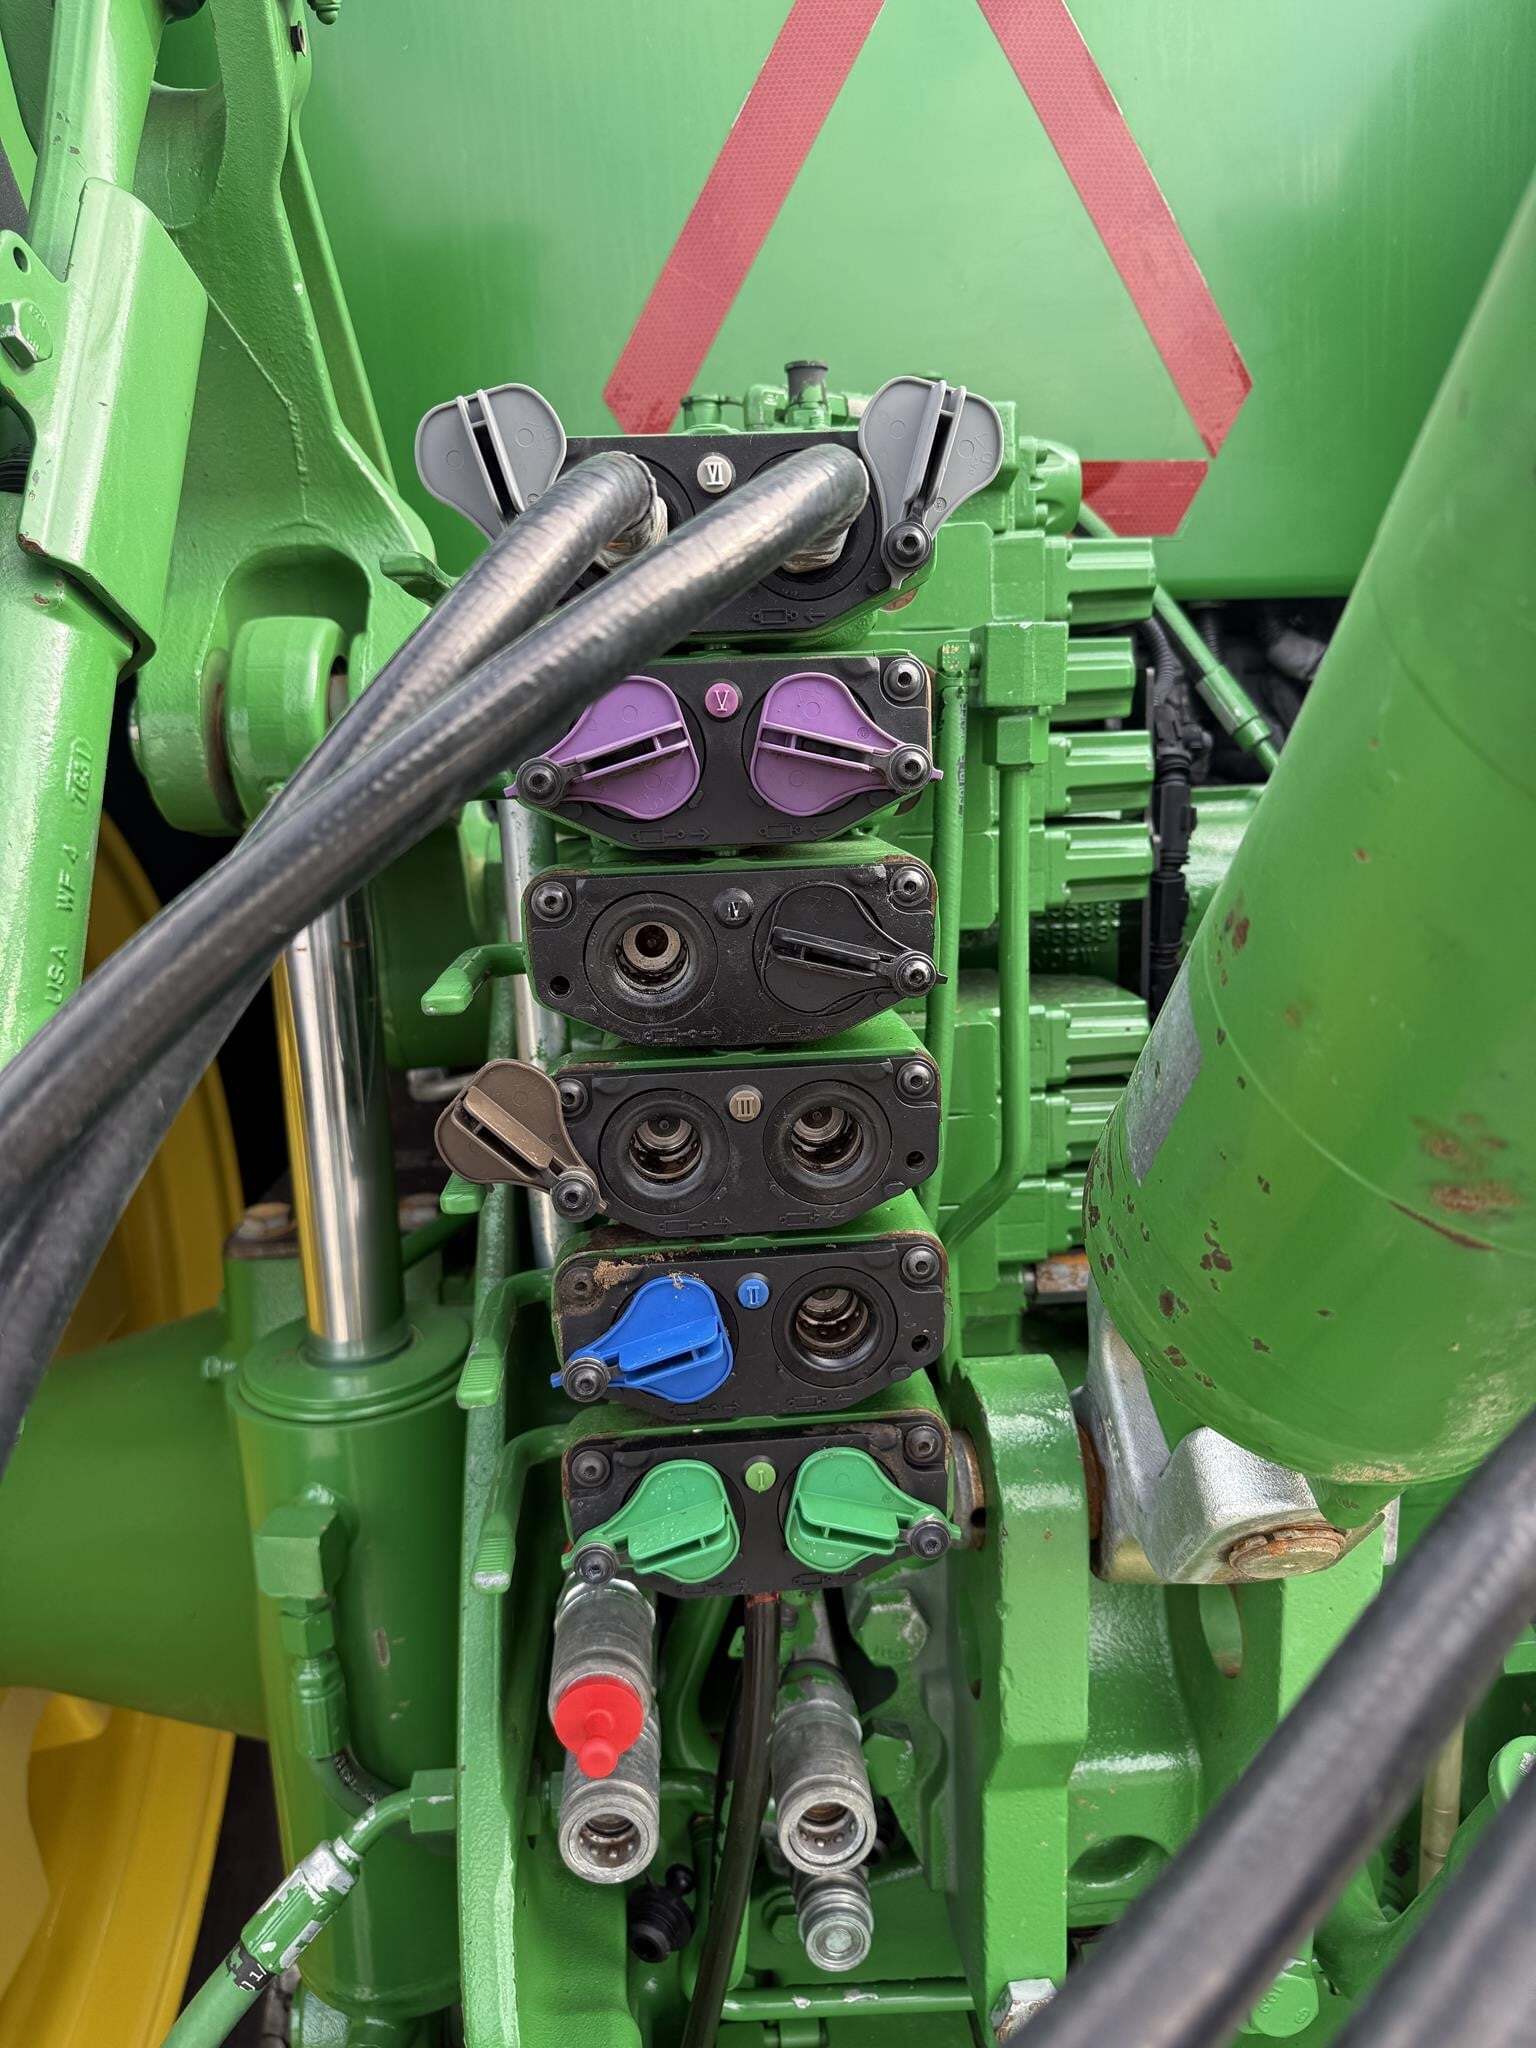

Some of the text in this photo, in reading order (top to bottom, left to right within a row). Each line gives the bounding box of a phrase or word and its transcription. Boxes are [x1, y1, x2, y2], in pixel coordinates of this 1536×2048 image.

[704, 461, 725, 486] VI
[714, 690, 731, 713] V
[46, 946, 69, 1006] USA
[735, 1096, 755, 1118] III
[746, 1285, 760, 1305] II
[757, 1469, 765, 1489] I
